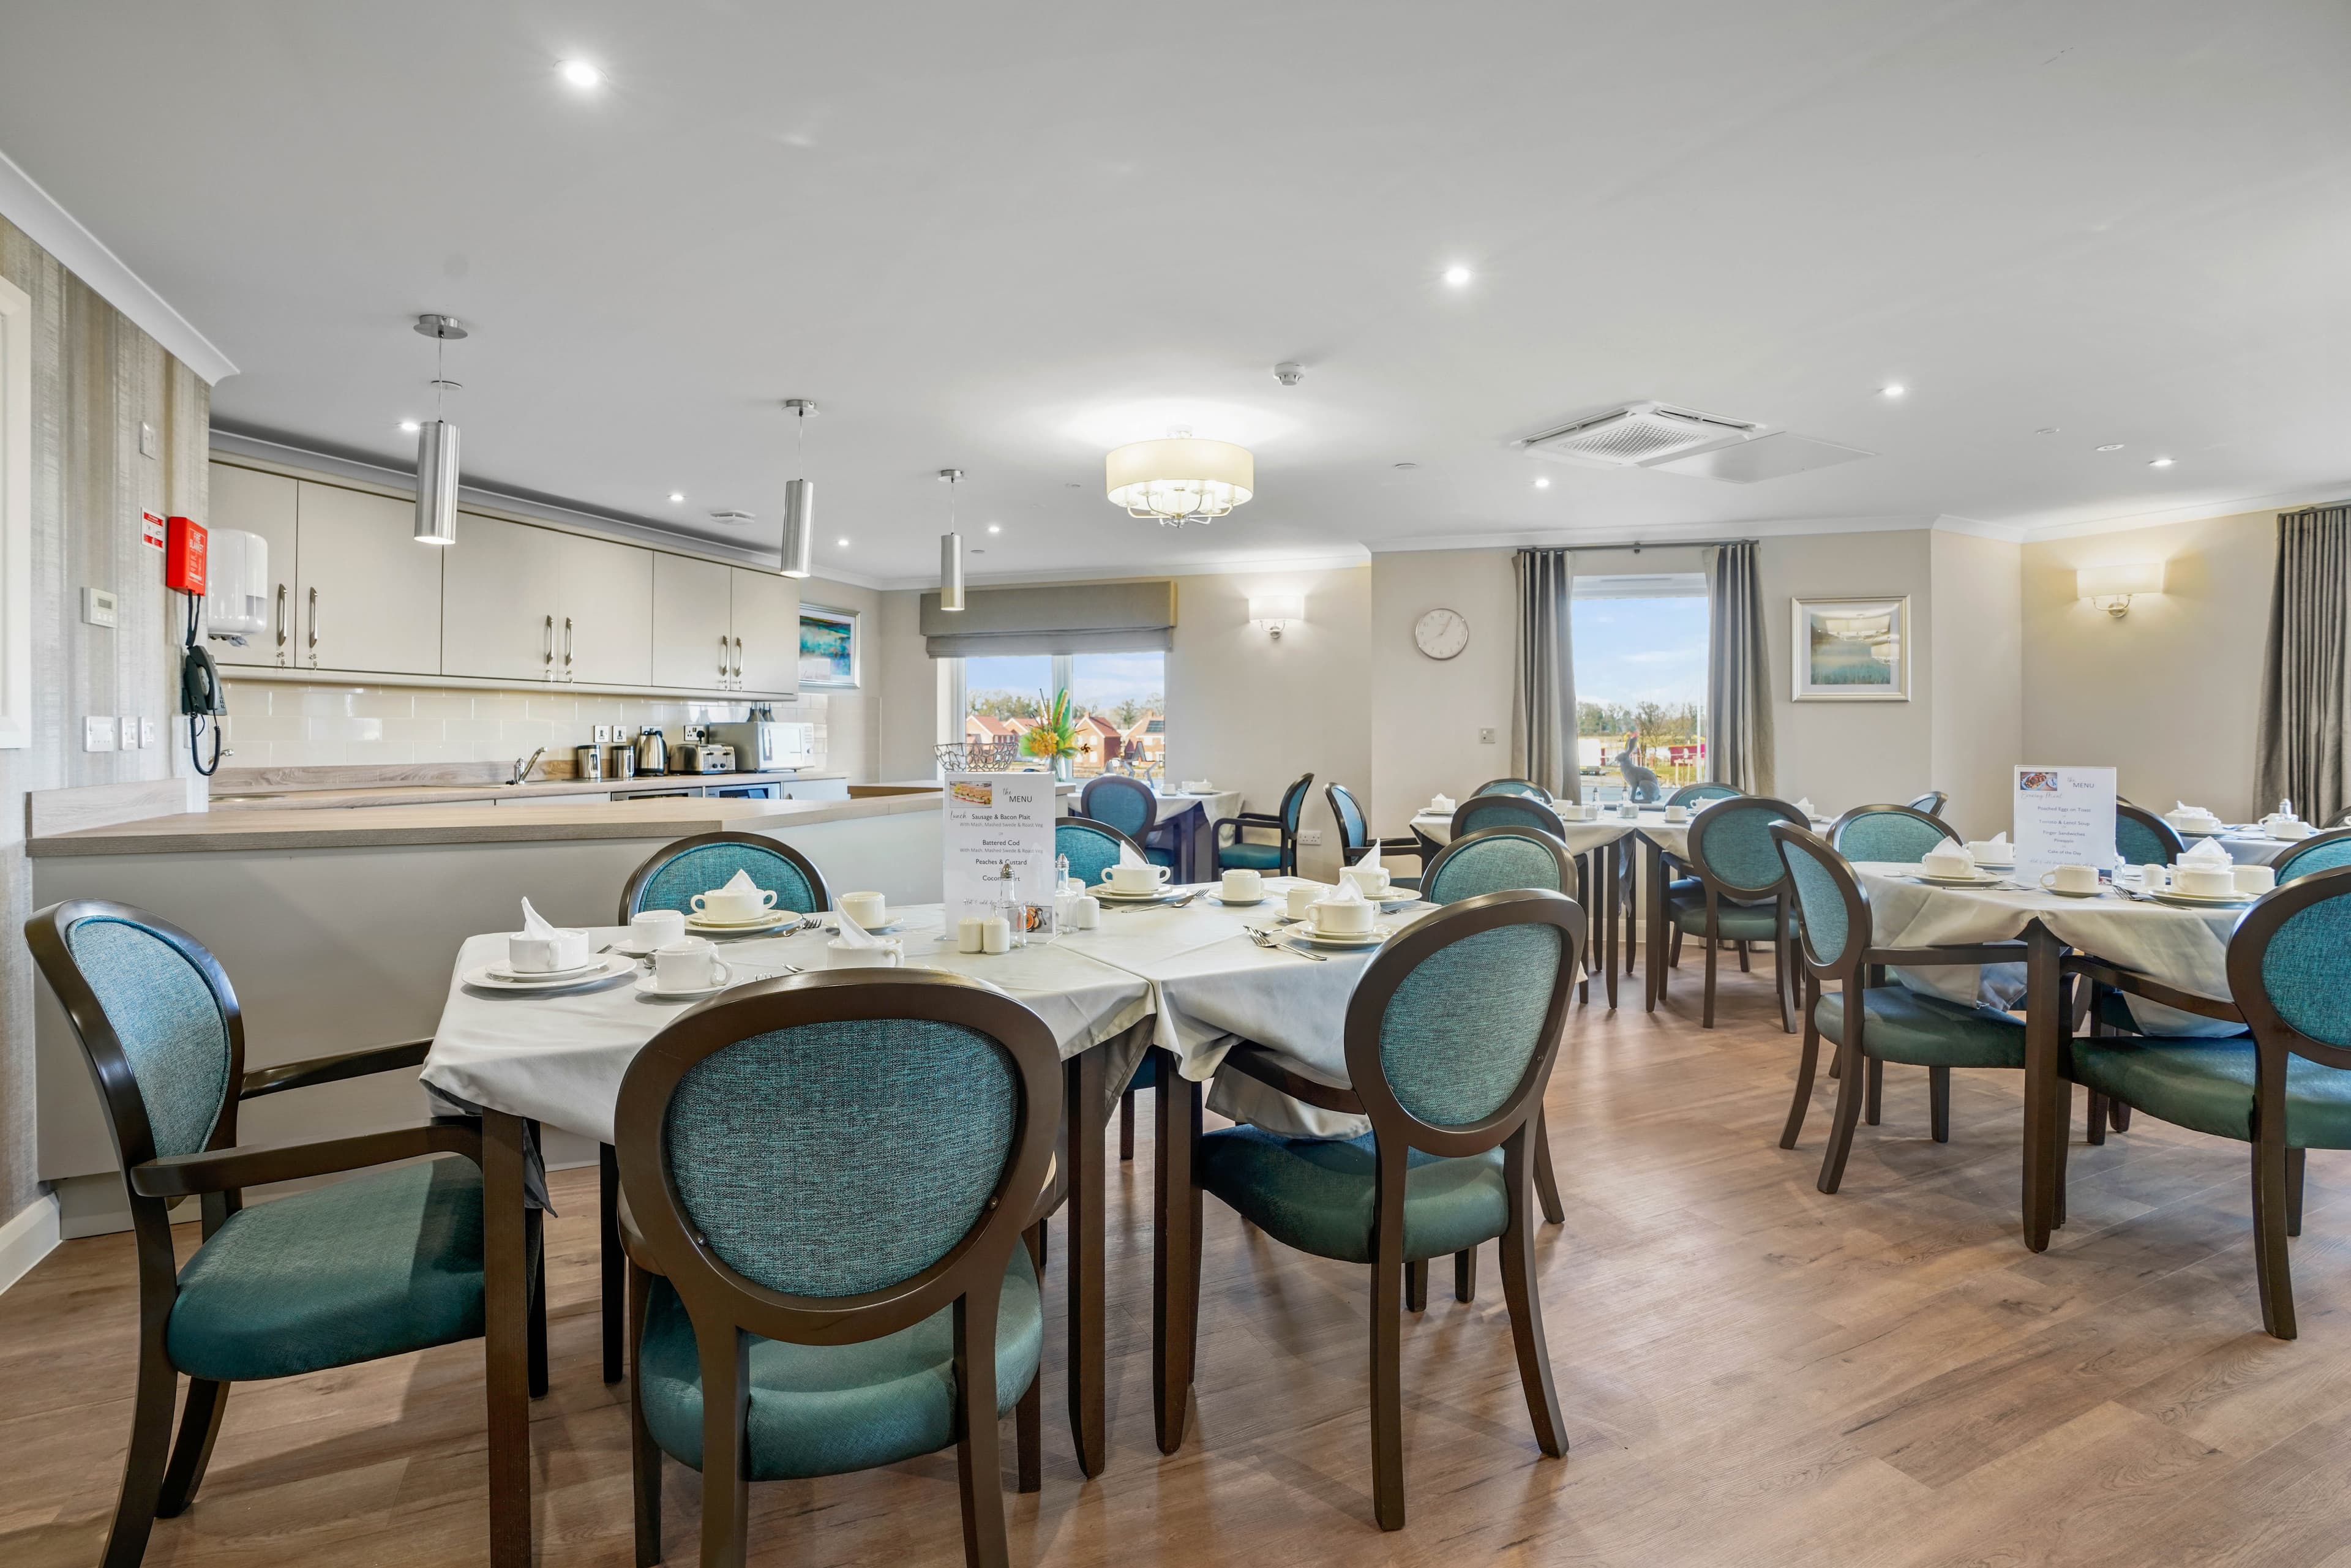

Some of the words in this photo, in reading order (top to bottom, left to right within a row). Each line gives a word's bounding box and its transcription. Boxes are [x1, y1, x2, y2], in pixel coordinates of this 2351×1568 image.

[193, 531, 201, 544] FIRE
[189, 539, 204, 554] BLANKET
[950, 811, 967, 820] Lunch
